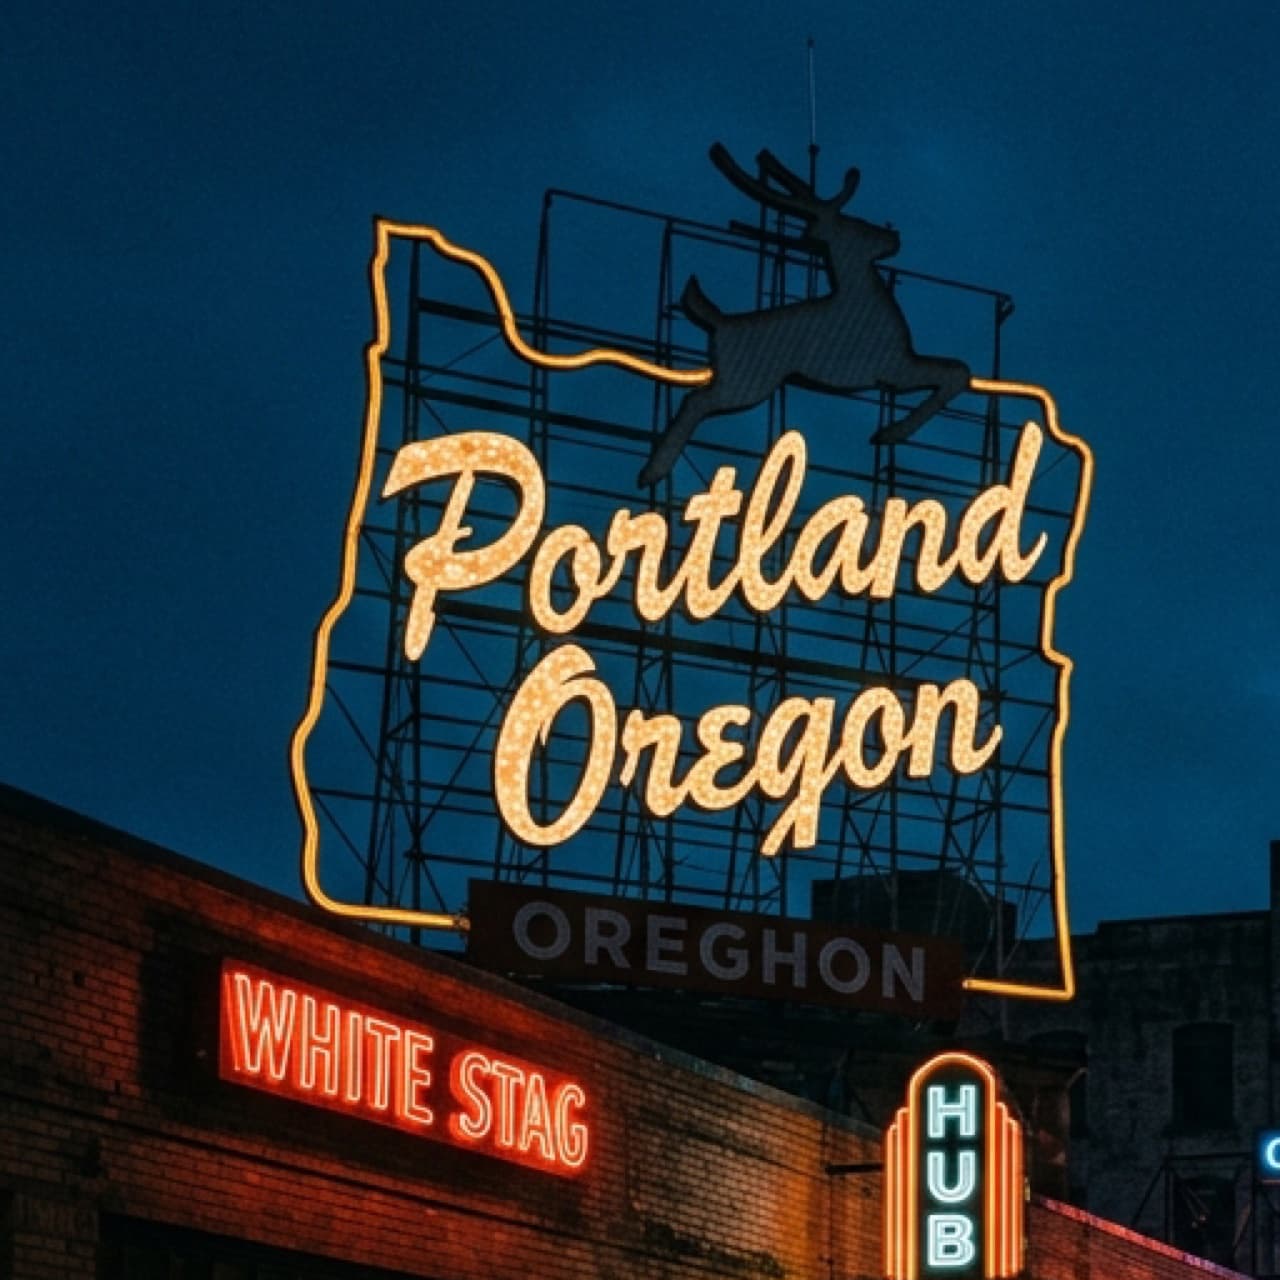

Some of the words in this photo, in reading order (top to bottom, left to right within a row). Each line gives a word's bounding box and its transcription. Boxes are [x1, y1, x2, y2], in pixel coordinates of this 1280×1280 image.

[383, 421, 1047, 661] Portland
[494, 643, 1002, 856] Oregon
[513, 901, 925, 1001] OREGHON
[231, 972, 434, 1125] WHITE
[457, 1052, 589, 1167] STAG
[926, 1084, 977, 1267] HUB
